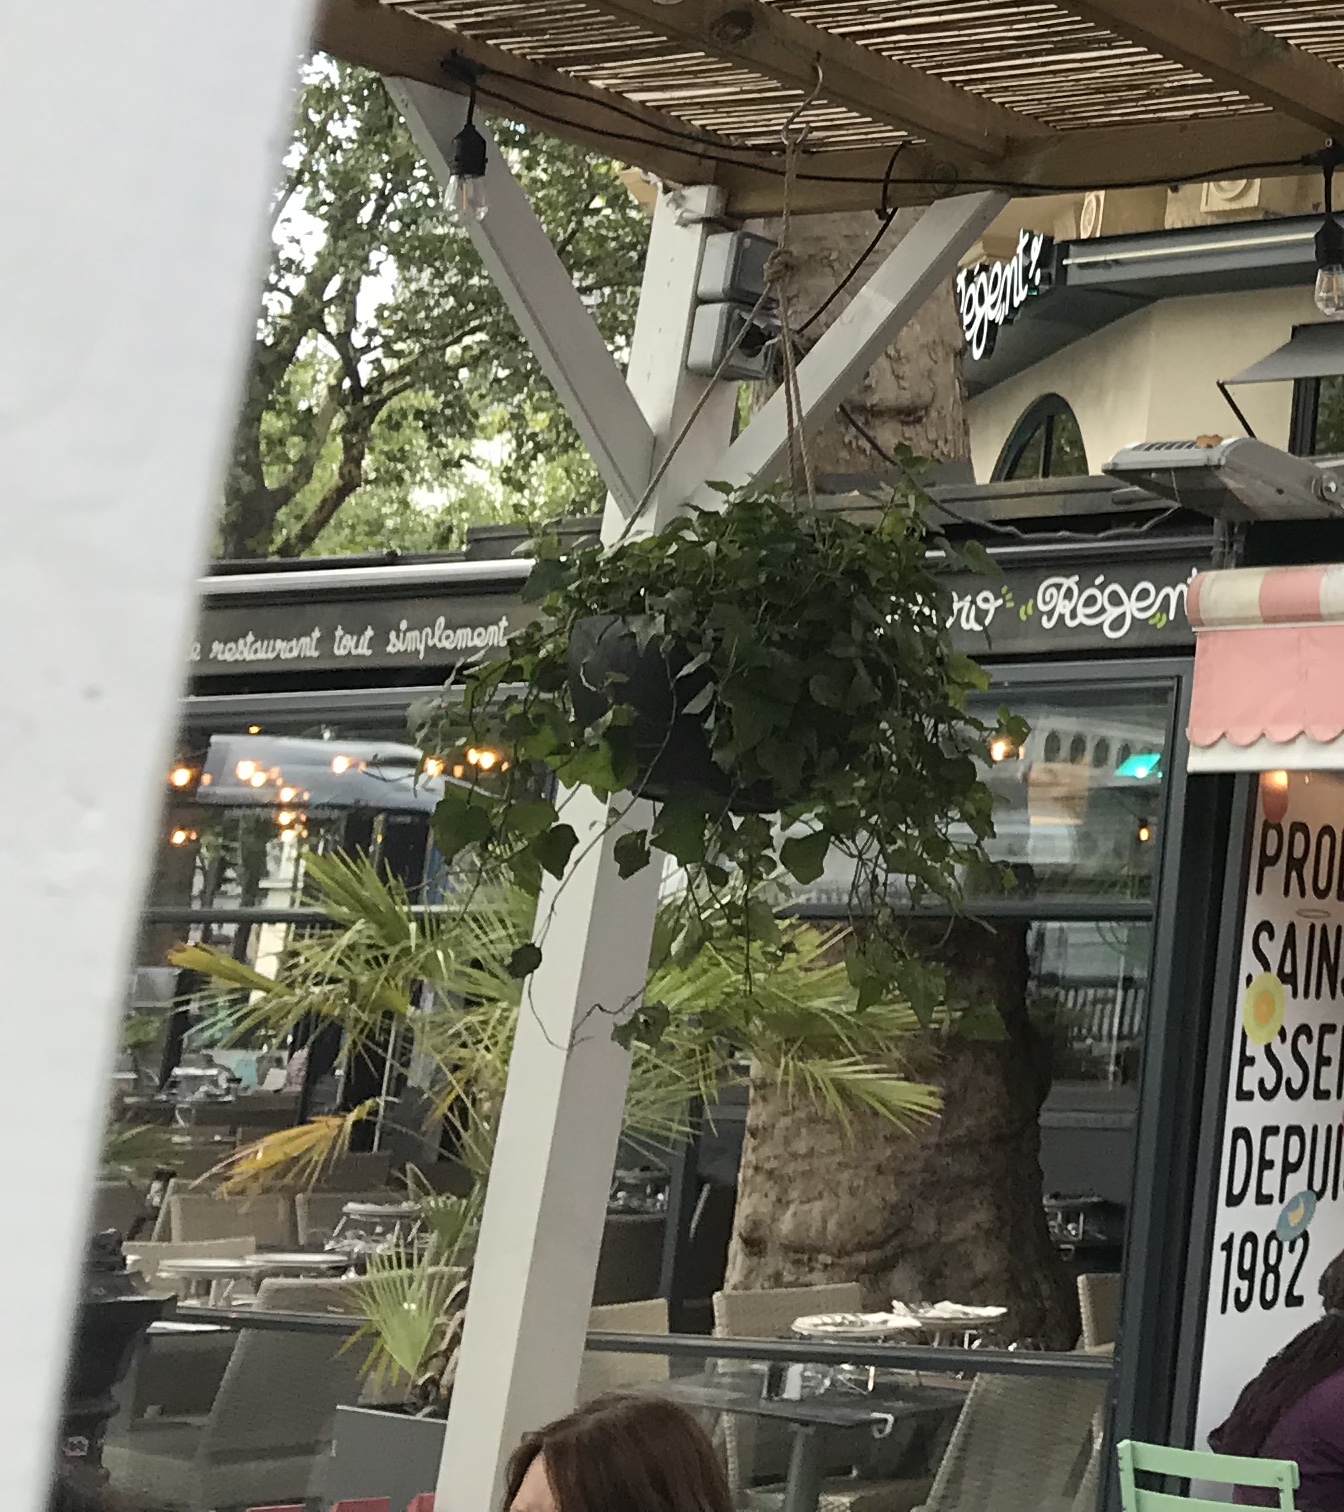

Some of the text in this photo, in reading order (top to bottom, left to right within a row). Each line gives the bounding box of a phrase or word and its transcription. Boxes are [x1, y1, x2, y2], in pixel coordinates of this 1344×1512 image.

[208, 625, 321, 662] restaurant
[333, 624, 375, 656] tout
[386, 615, 508, 660] simplement
[1037, 567, 1197, 639] Régen
[1220, 1229, 1310, 1315] 1982
